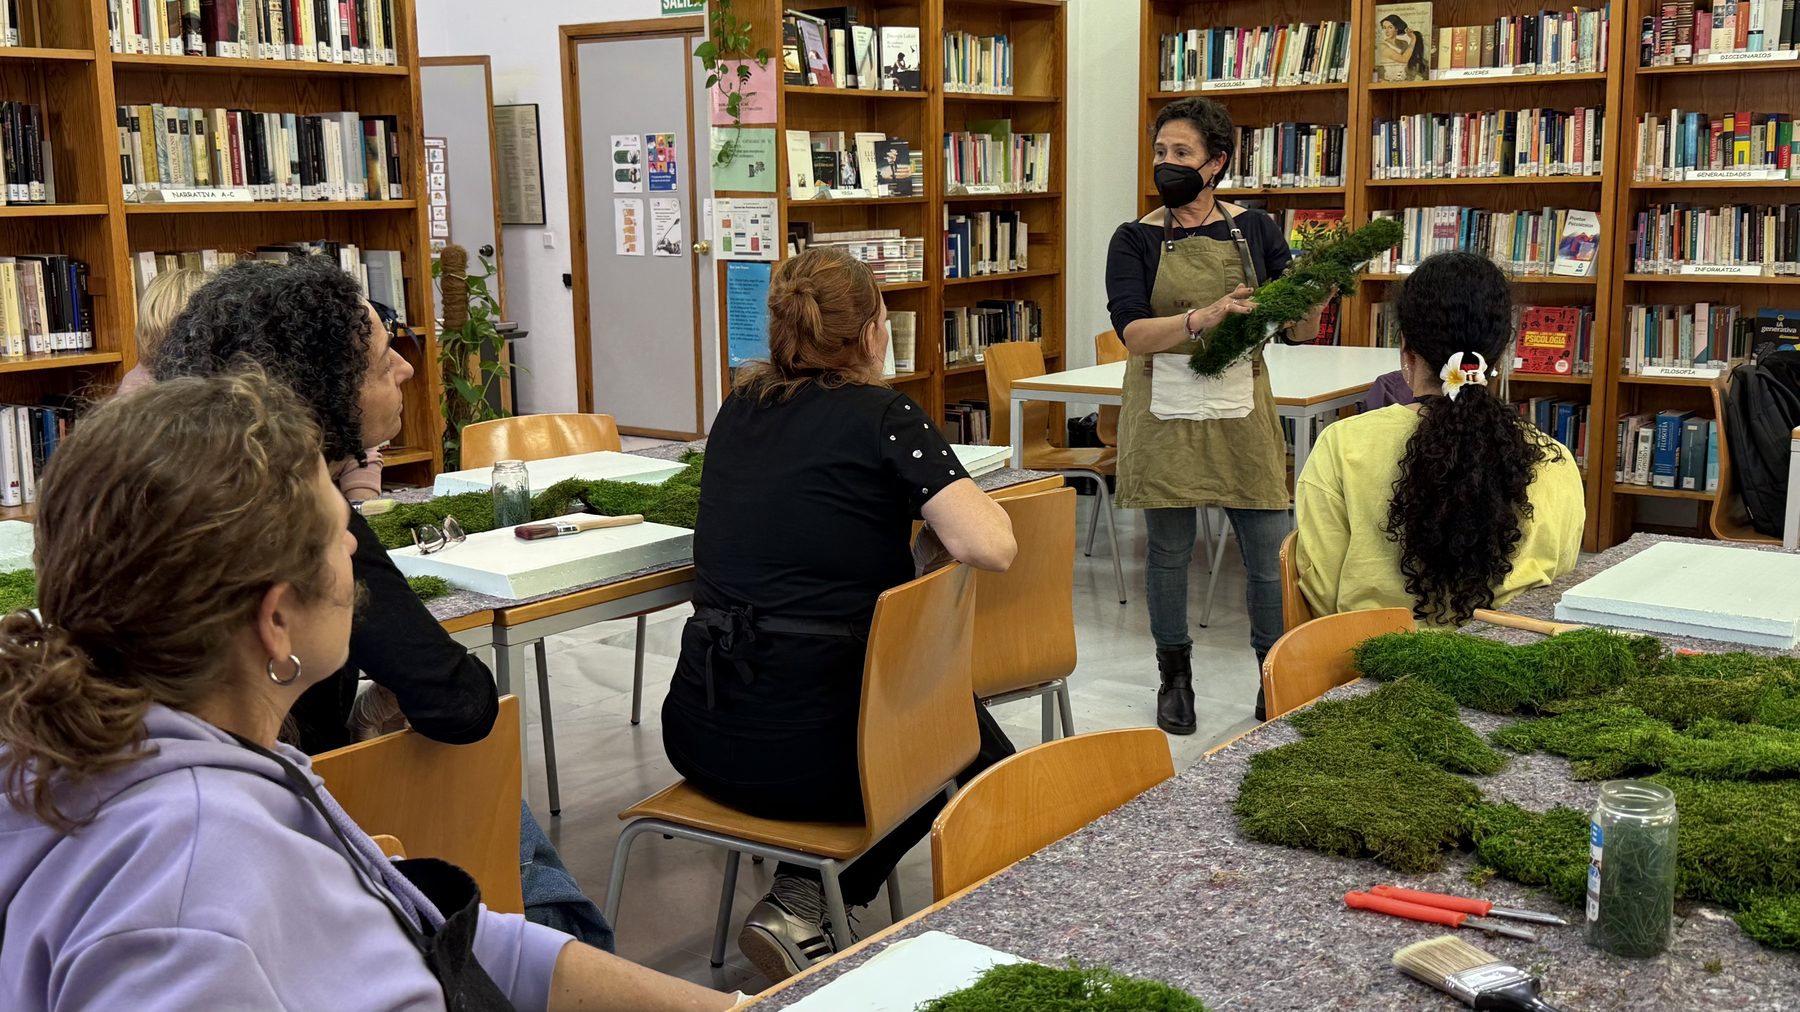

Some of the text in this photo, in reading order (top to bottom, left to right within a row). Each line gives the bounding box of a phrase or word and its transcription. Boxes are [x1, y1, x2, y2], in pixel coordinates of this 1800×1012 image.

[663, 0, 703, 9] SALI
[1720, 52, 1772, 60] DICCIONARIOS
[1760, 326, 1797, 334] generativa
